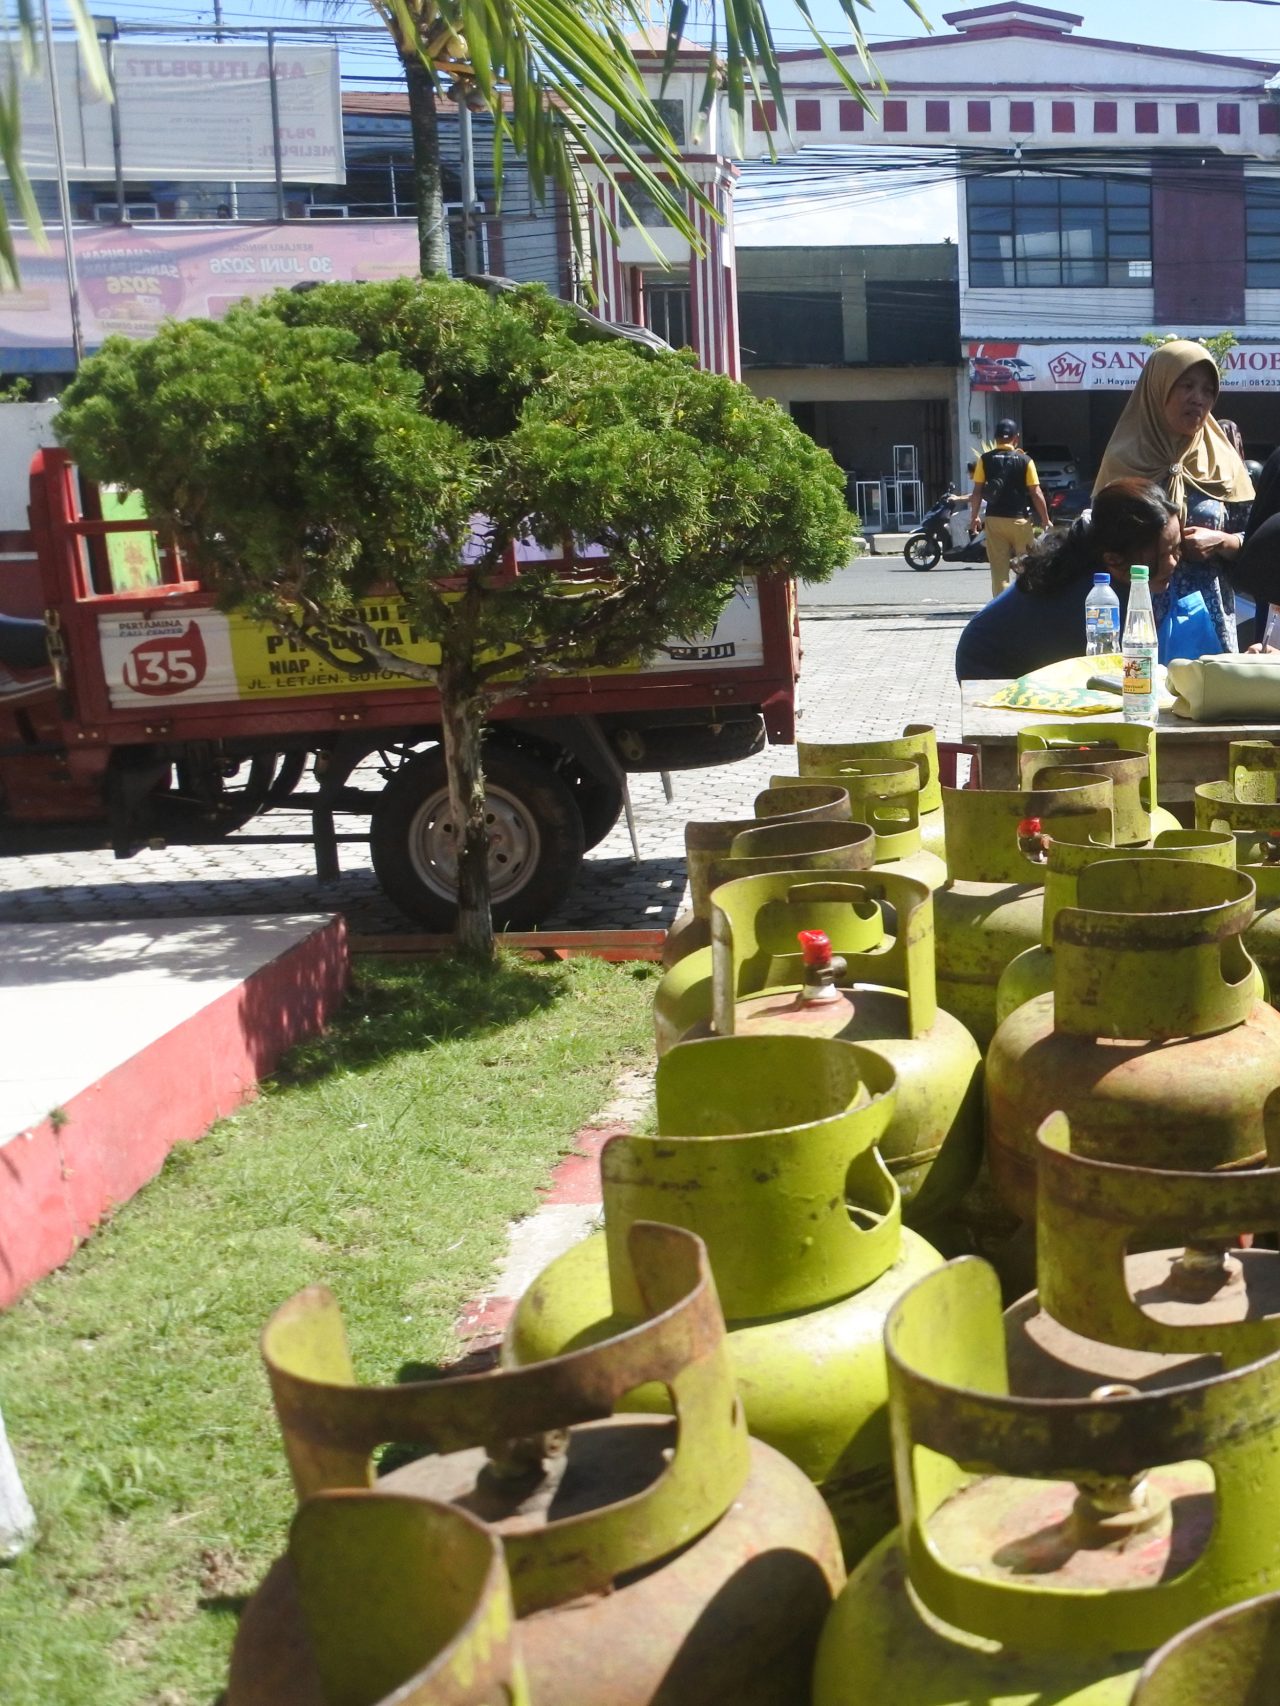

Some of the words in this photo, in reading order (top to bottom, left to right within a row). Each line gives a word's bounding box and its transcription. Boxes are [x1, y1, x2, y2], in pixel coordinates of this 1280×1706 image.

[1052, 357, 1082, 378] SM
[1091, 351, 1147, 369] SAN
[119, 620, 182, 630] PERTAMINA
[119, 629, 143, 637] CALL
[146, 627, 183, 636] CENTER
[125, 649, 197, 687] 135
[269, 659, 311, 676] NIAP
[247, 678, 272, 690] JL.
[276, 672, 343, 689] LETJEN.
